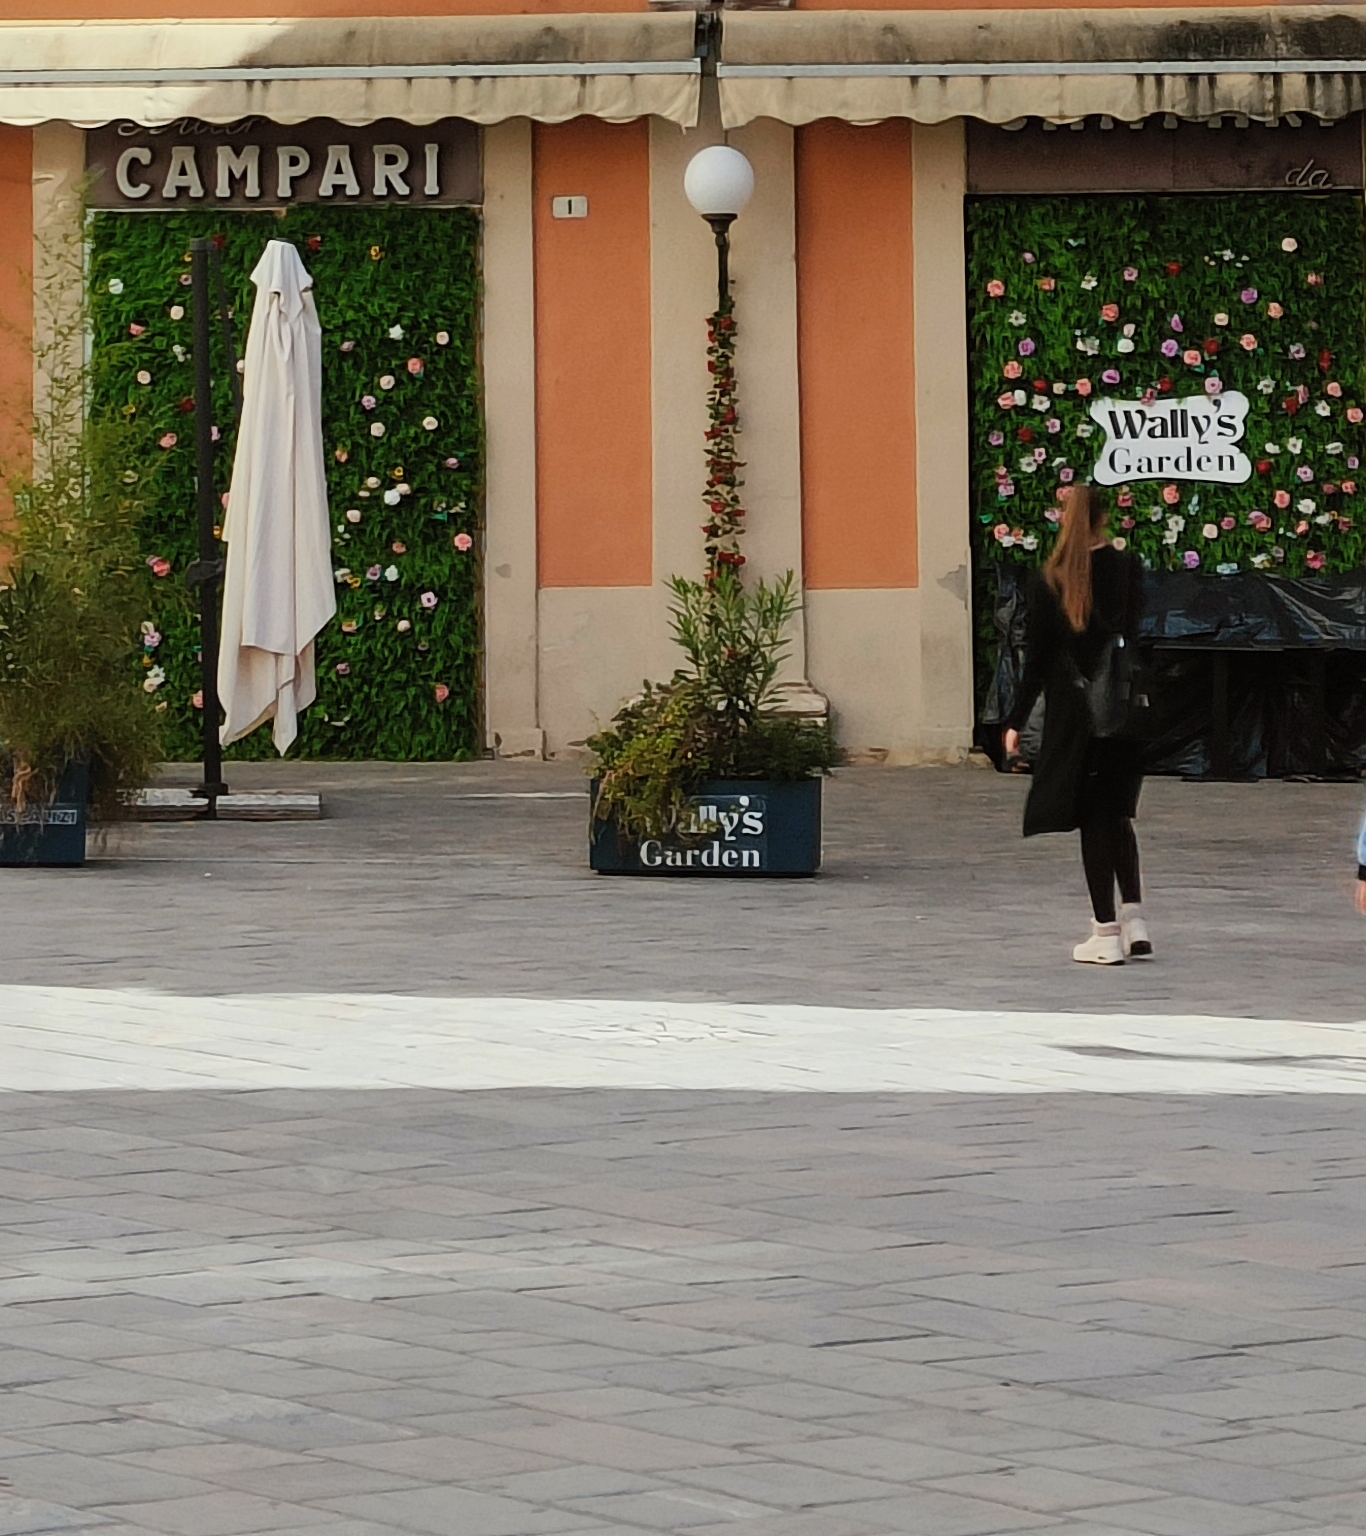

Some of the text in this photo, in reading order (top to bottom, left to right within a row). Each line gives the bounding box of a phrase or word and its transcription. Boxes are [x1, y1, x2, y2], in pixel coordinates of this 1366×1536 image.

[116, 143, 439, 198] CAMPARI
[1285, 159, 1333, 189] da
[1108, 398, 1238, 444] Wally's
[1108, 447, 1236, 475] Garden
[640, 839, 761, 868] Garden
